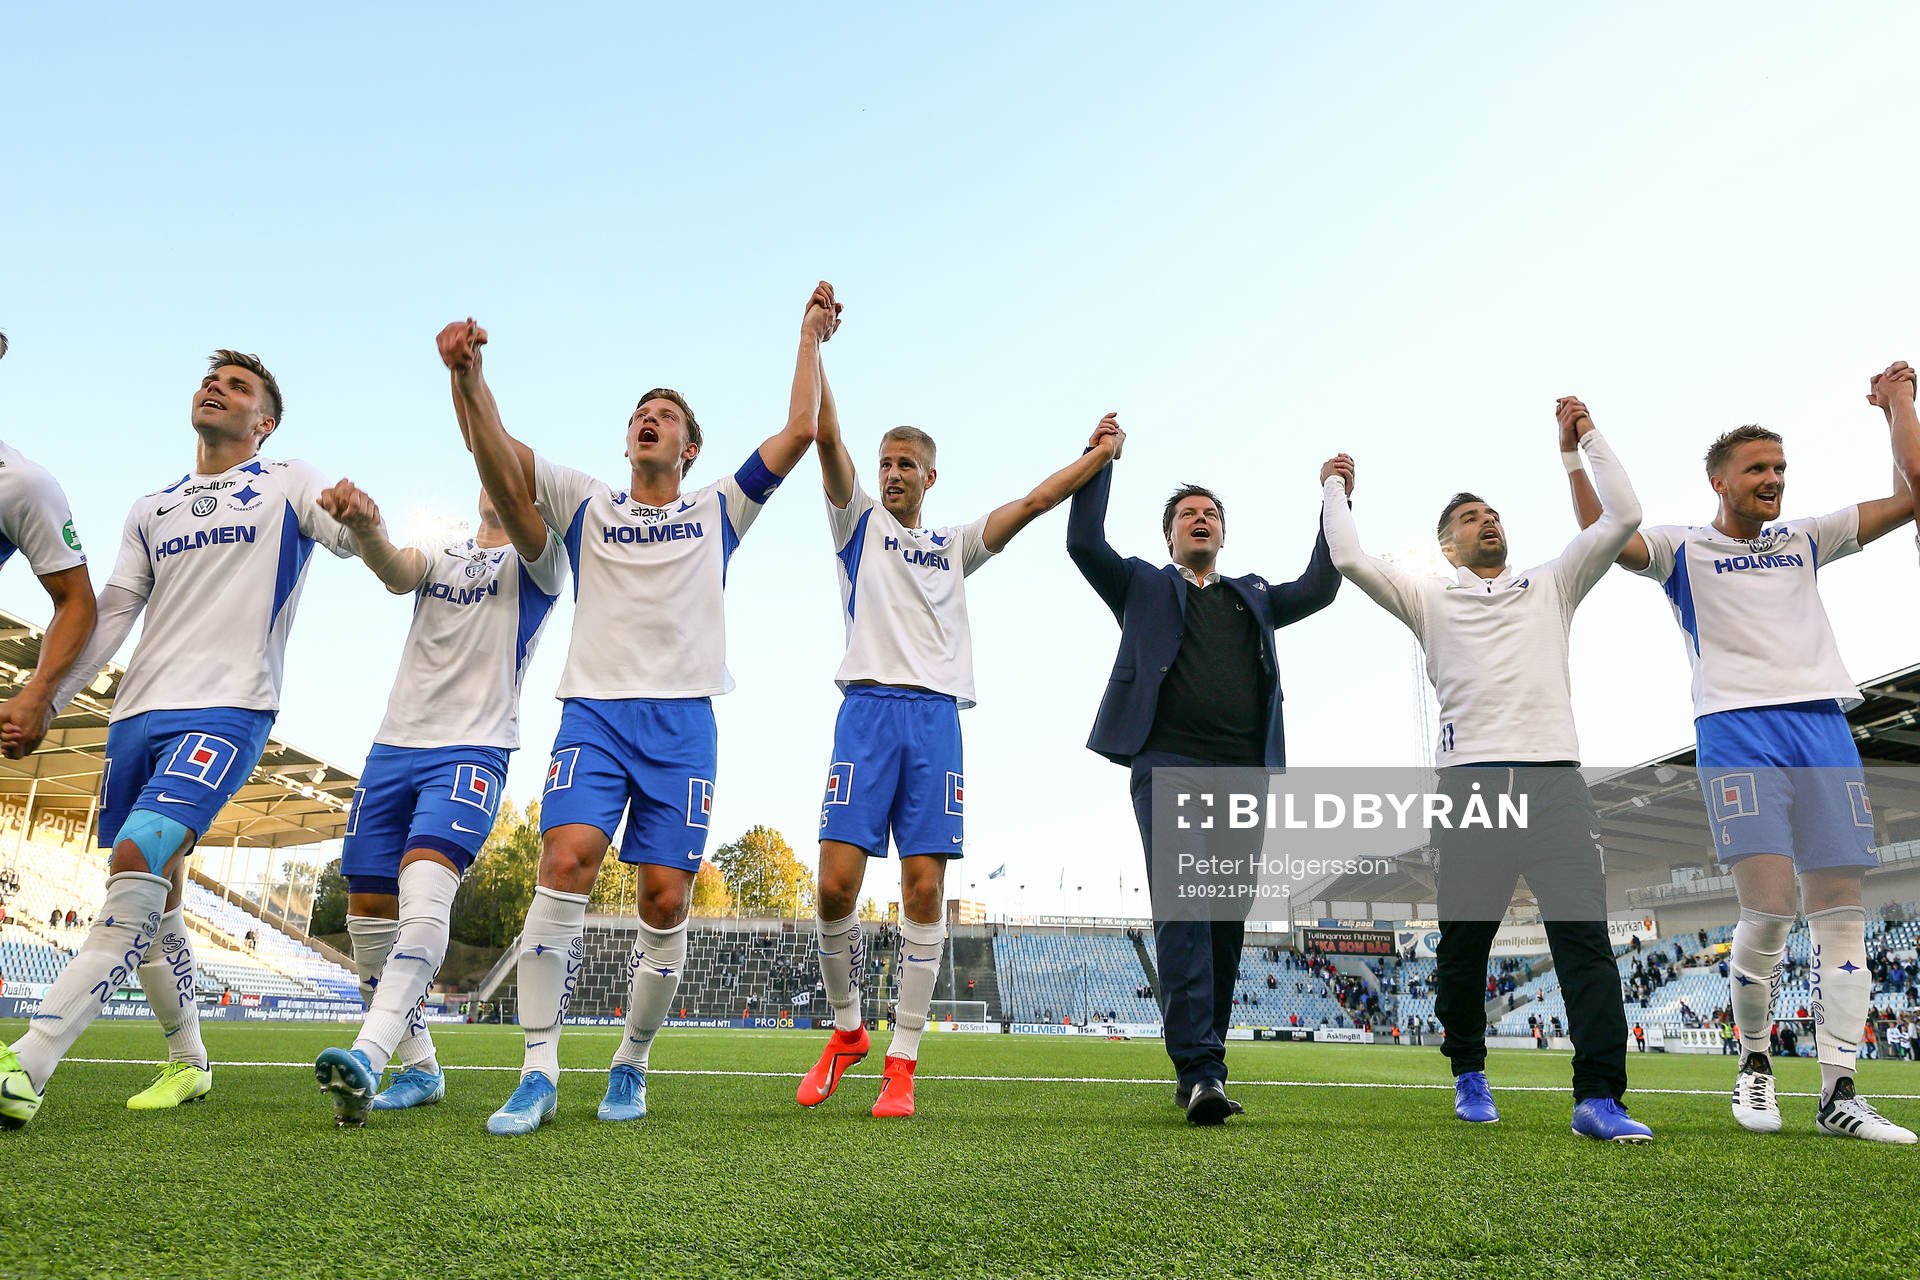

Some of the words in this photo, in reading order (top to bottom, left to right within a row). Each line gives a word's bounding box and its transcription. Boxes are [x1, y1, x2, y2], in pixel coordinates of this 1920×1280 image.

[602, 522, 704, 544] HOLMEN
[156, 525, 256, 561] HOLMEN
[884, 535, 950, 571] HLMEN
[1714, 553, 1804, 574] HOLMEN
[1721, 825, 1731, 846] 6
[1338, 941, 1365, 953] SOM
[1366, 940, 1391, 954] BÄR
[102, 1003, 113, 1016] du
[114, 1003, 135, 1016] alltid
[136, 1003, 150, 1016] den
[577, 1017, 597, 1026] följer
[598, 1017, 609, 1025] du
[609, 1017, 625, 1026] allti
[670, 1019, 699, 1028] sporten
[755, 1018, 794, 1029] PROJOB
[1013, 1024, 1067, 1034] HOLMEN
